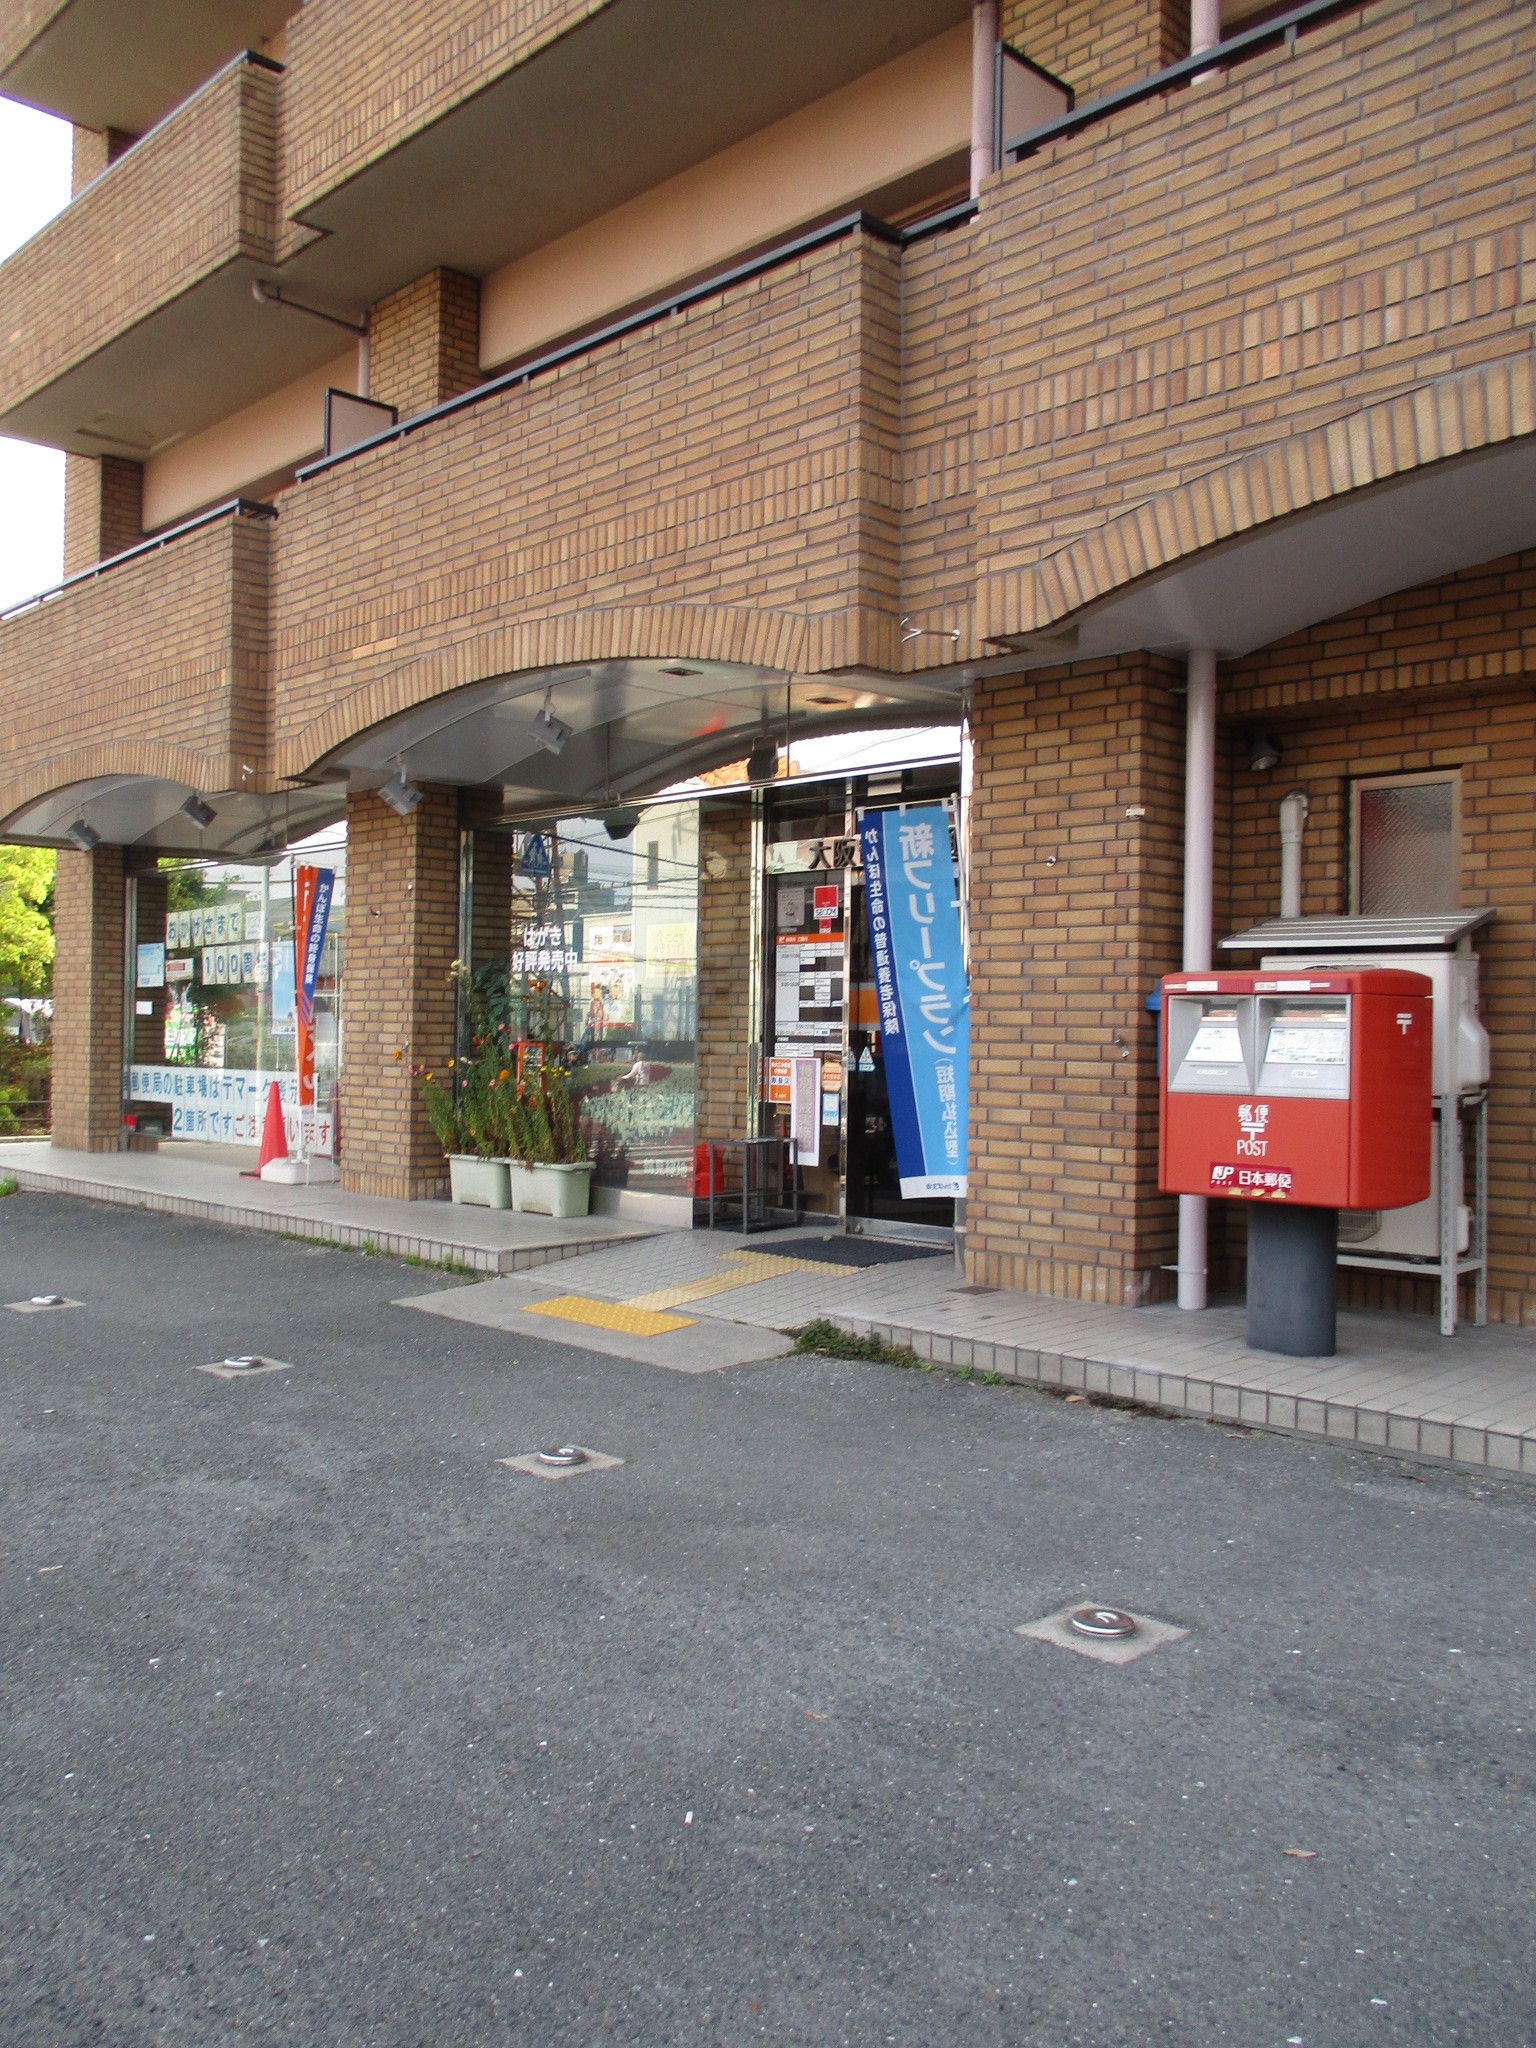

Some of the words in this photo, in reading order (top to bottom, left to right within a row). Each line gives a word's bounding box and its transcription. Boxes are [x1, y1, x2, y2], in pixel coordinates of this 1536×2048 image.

[523, 926, 562, 947] はがき
[511, 949, 578, 973] 好評発売中
[1237, 1104, 1269, 1124] 郵便
[1236, 1139, 1269, 1157] POST
[1238, 1170, 1292, 1189] 日本郵便
